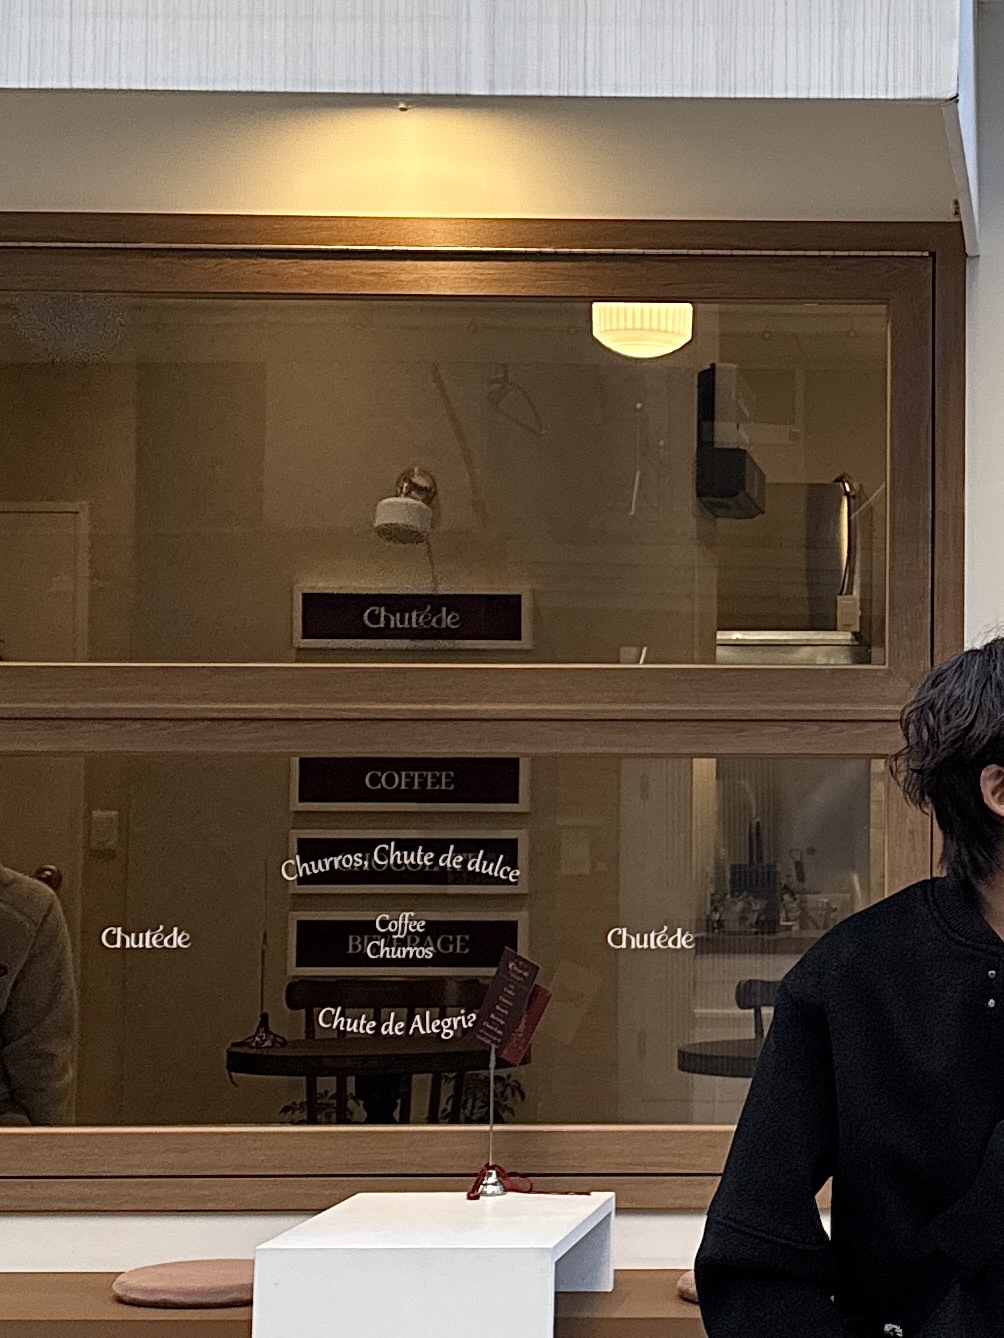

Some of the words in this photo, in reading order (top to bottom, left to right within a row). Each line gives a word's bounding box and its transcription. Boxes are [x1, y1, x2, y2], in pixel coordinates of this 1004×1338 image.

[364, 770, 455, 790] COFFEE
[281, 853, 369, 881] Churros,
[373, 841, 434, 866] Chute
[438, 844, 464, 869] de
[467, 849, 521, 882] dulce
[101, 925, 191, 949] Chutéde
[375, 912, 426, 939] Coffee
[607, 925, 696, 950] Chutéde
[366, 938, 434, 959] Churros
[318, 1006, 377, 1035] Chute
[380, 1011, 405, 1036] de
